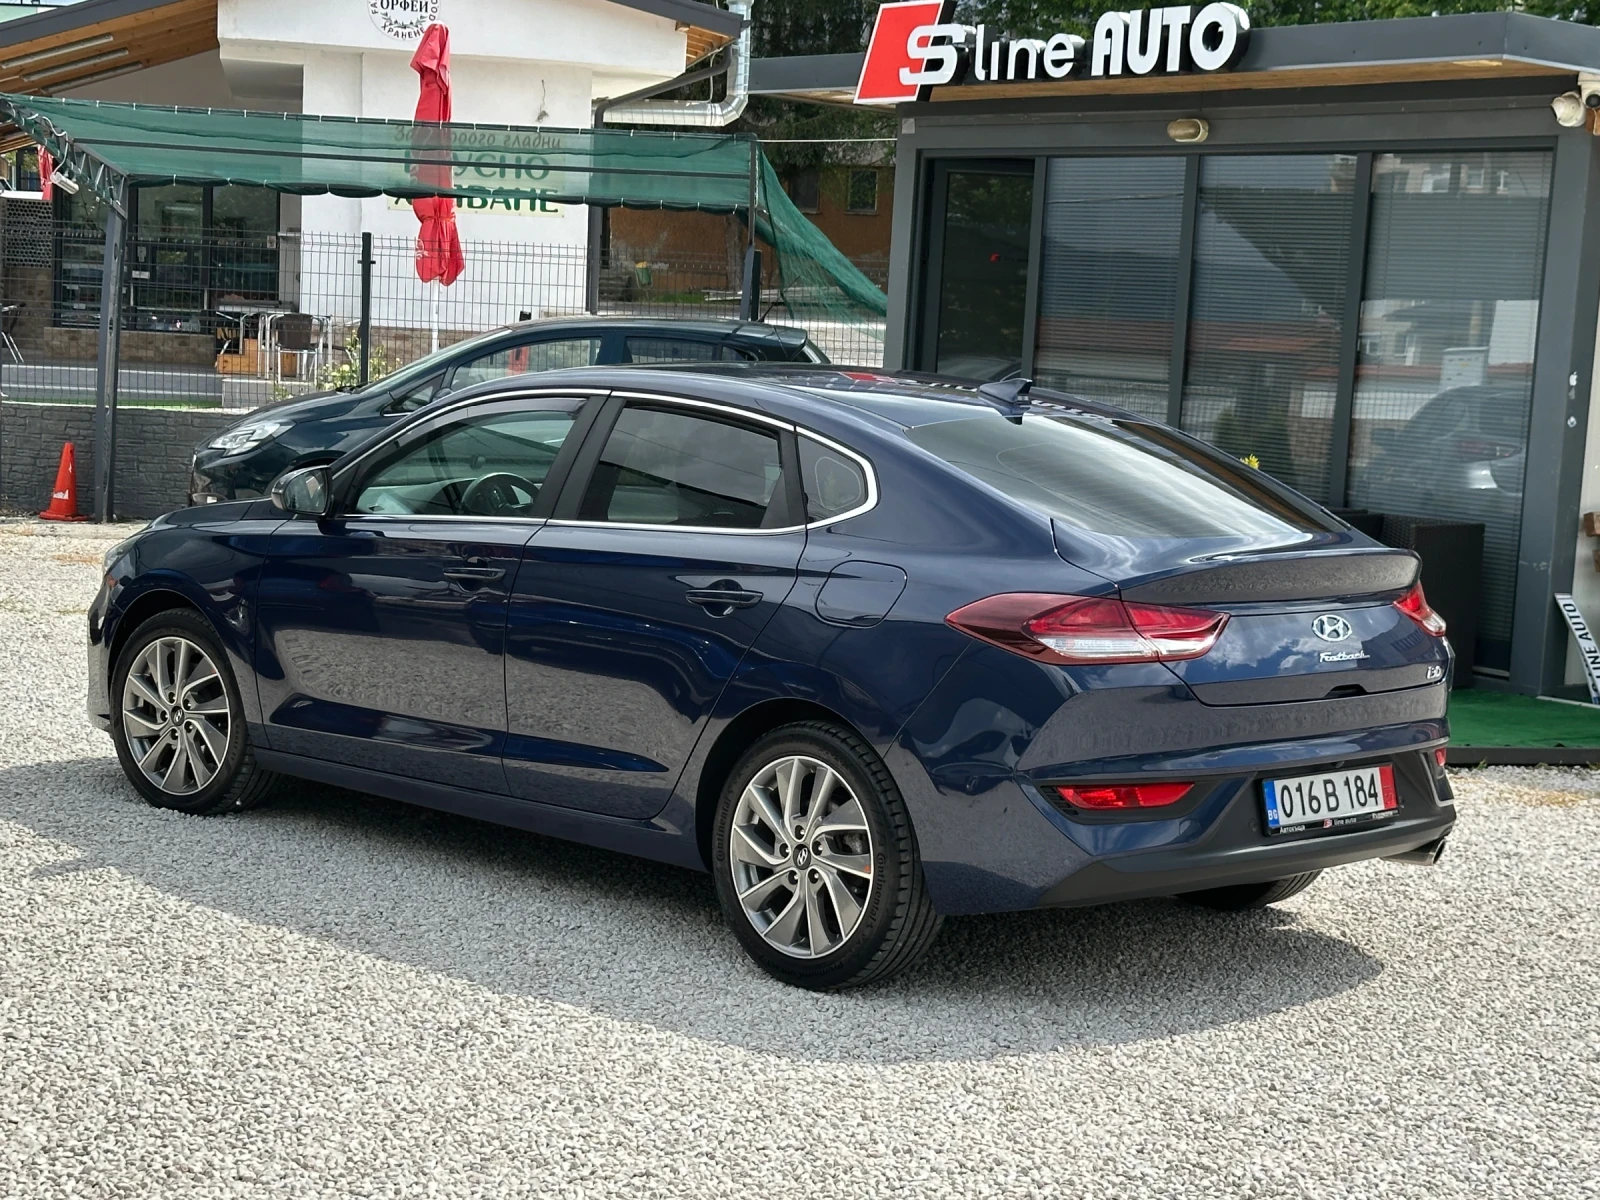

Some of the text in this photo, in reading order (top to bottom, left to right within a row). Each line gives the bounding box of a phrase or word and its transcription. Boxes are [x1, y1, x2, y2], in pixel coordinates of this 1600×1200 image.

[1091, 2, 1248, 76] AUTO
[503, 132, 561, 149] гладни
[404, 150, 550, 181] УСНО
[1562, 603, 1592, 641] AUTO
[1426, 665, 1442, 680] i30
[716, 796, 732, 862] Continental
[1267, 809, 1278, 820] BG
[869, 852, 886, 922] Continental
